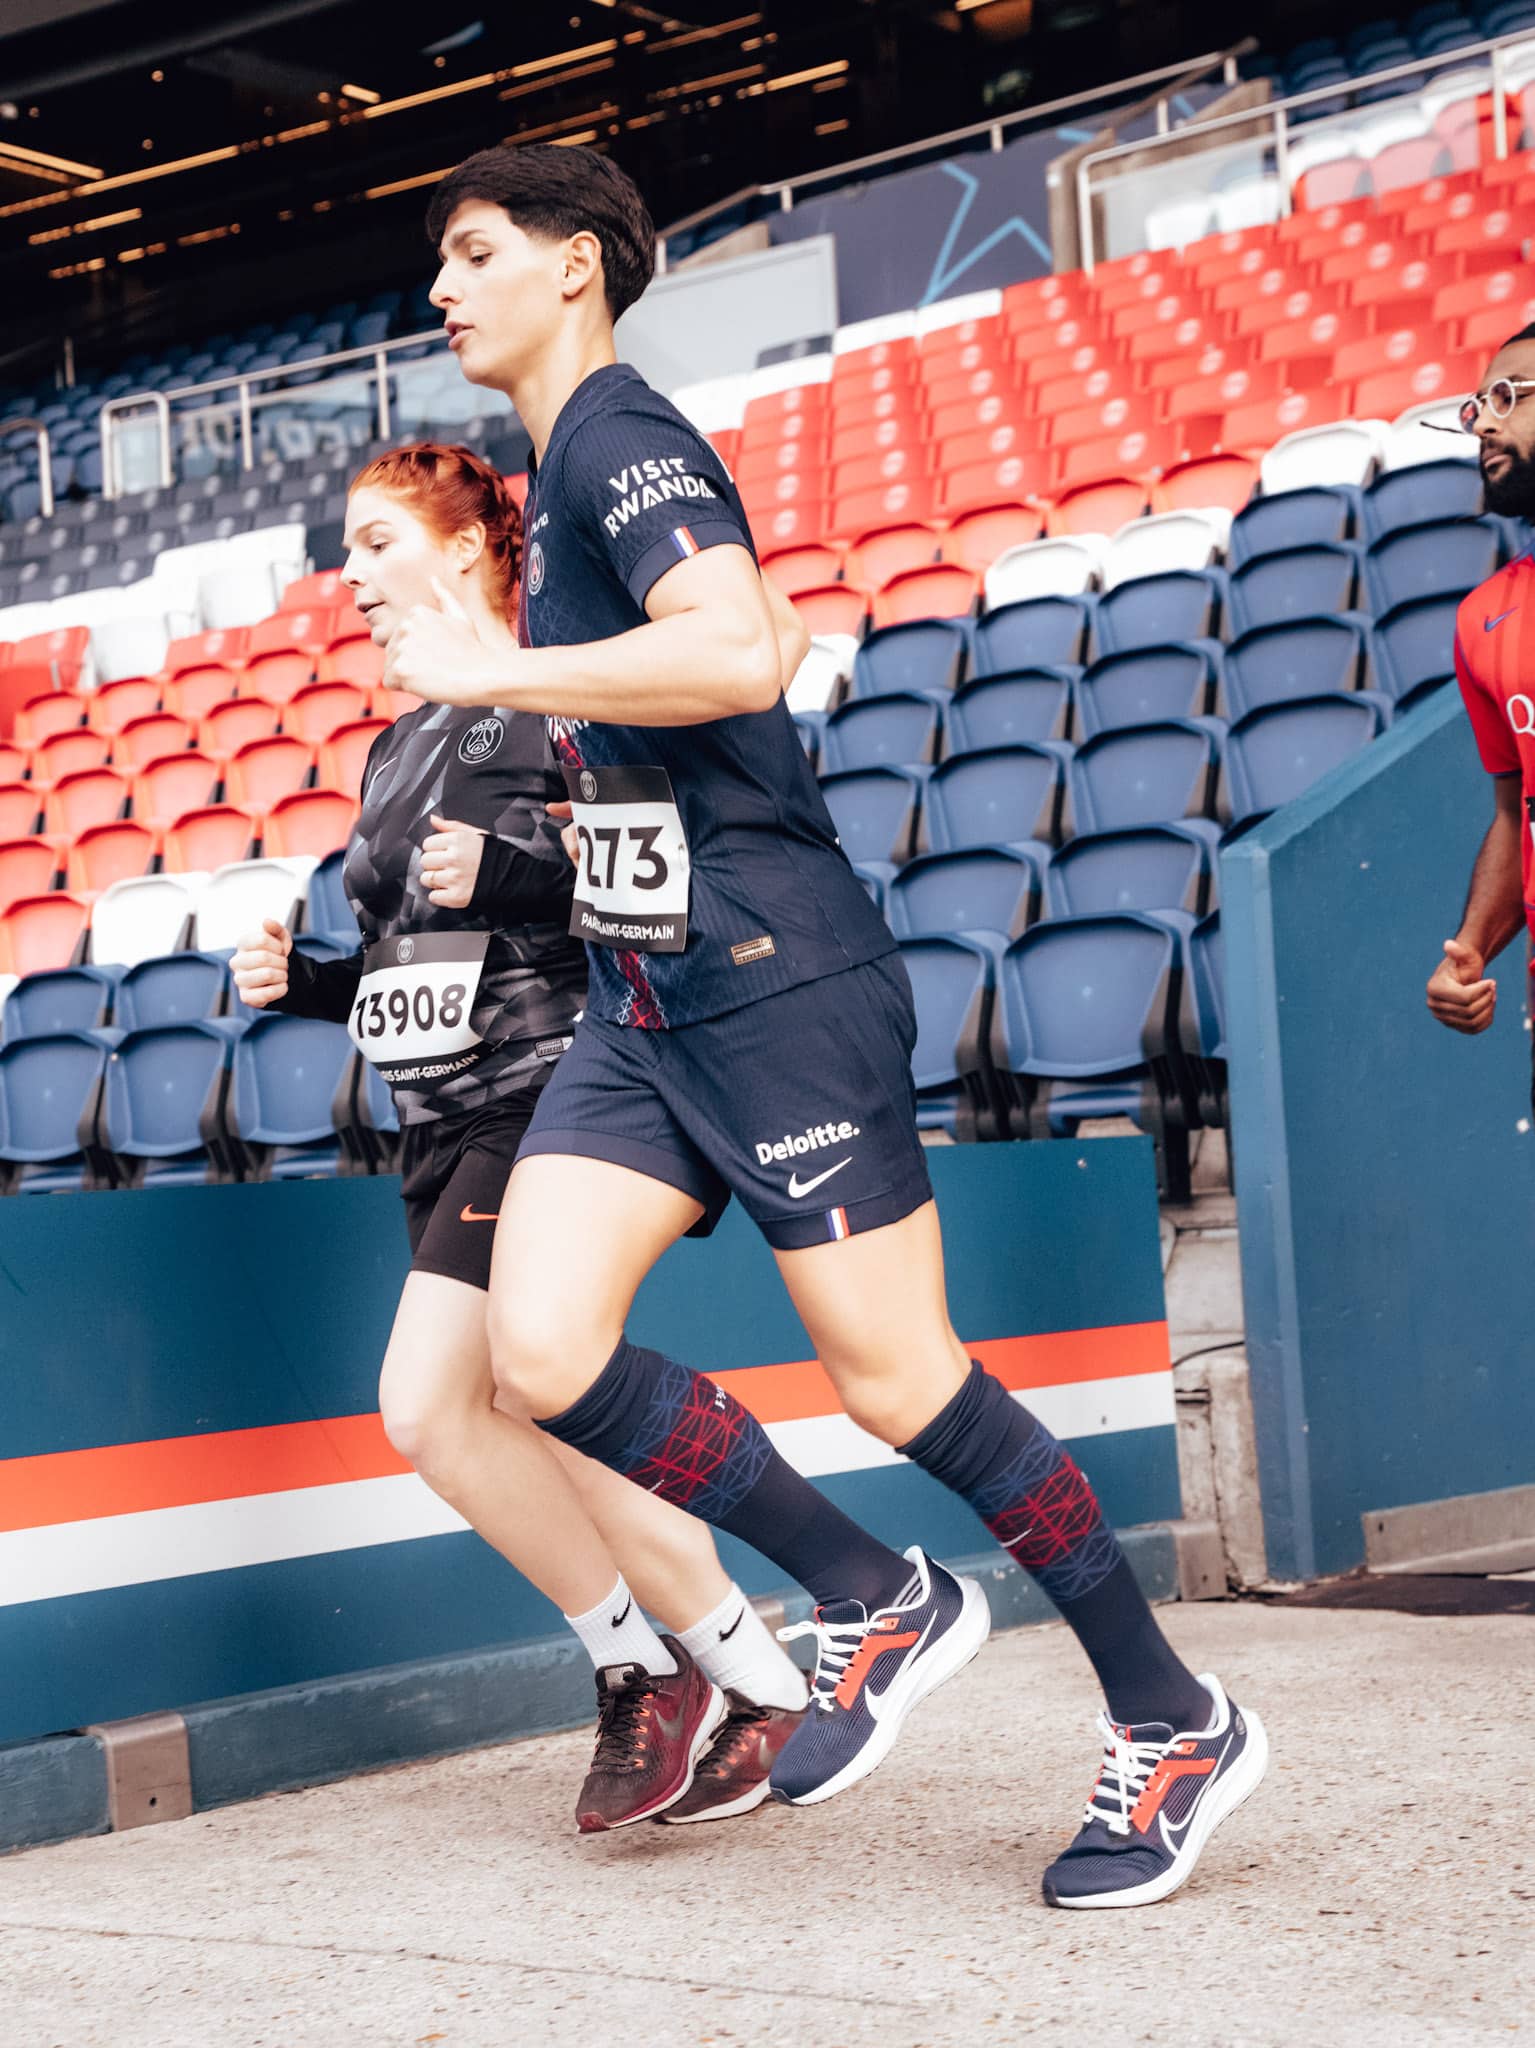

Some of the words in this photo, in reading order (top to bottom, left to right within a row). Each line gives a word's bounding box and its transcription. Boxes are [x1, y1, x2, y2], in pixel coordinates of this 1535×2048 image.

[608, 458, 685, 494] VISIT
[604, 475, 716, 538] RWANDA
[355, 984, 466, 1039] 13908
[394, 1054, 480, 1081] SAINT-GERMAIN
[755, 1121, 860, 1165] Deloitte.
